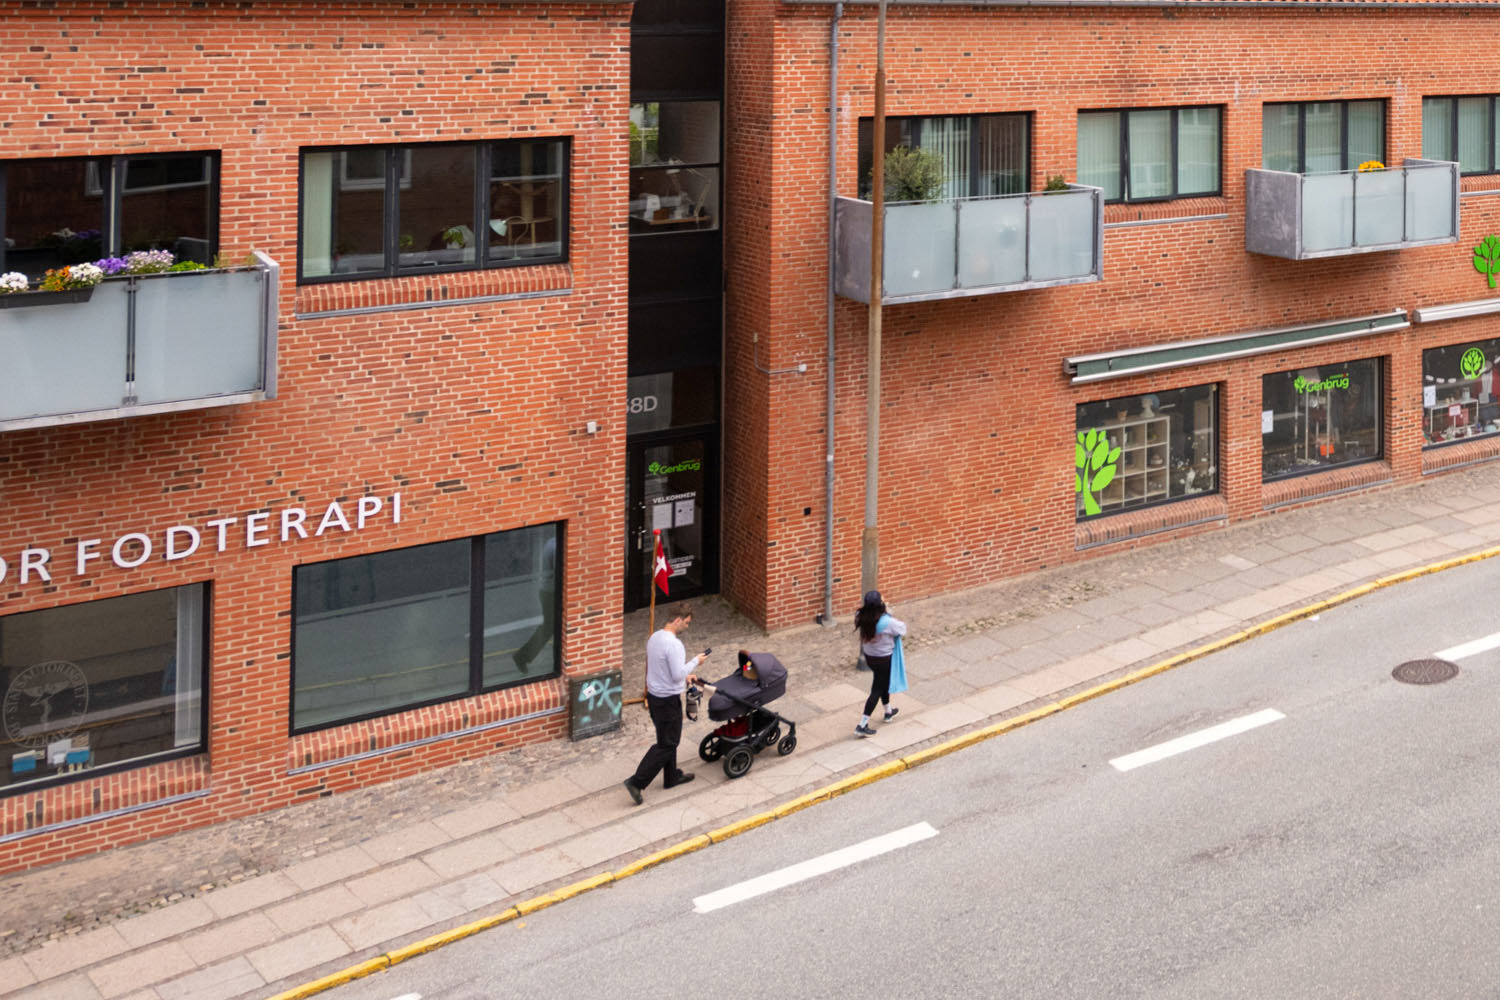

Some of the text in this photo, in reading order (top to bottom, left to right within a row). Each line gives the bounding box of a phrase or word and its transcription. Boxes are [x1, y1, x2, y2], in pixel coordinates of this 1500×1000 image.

[1306, 378, 1349, 392] Genbrug
[626, 395, 658, 414] 8D
[660, 463, 701, 475] Genbrug
[652, 491, 697, 504] VELKOMMEN
[0, 492, 401, 585] R FODTERAPI
